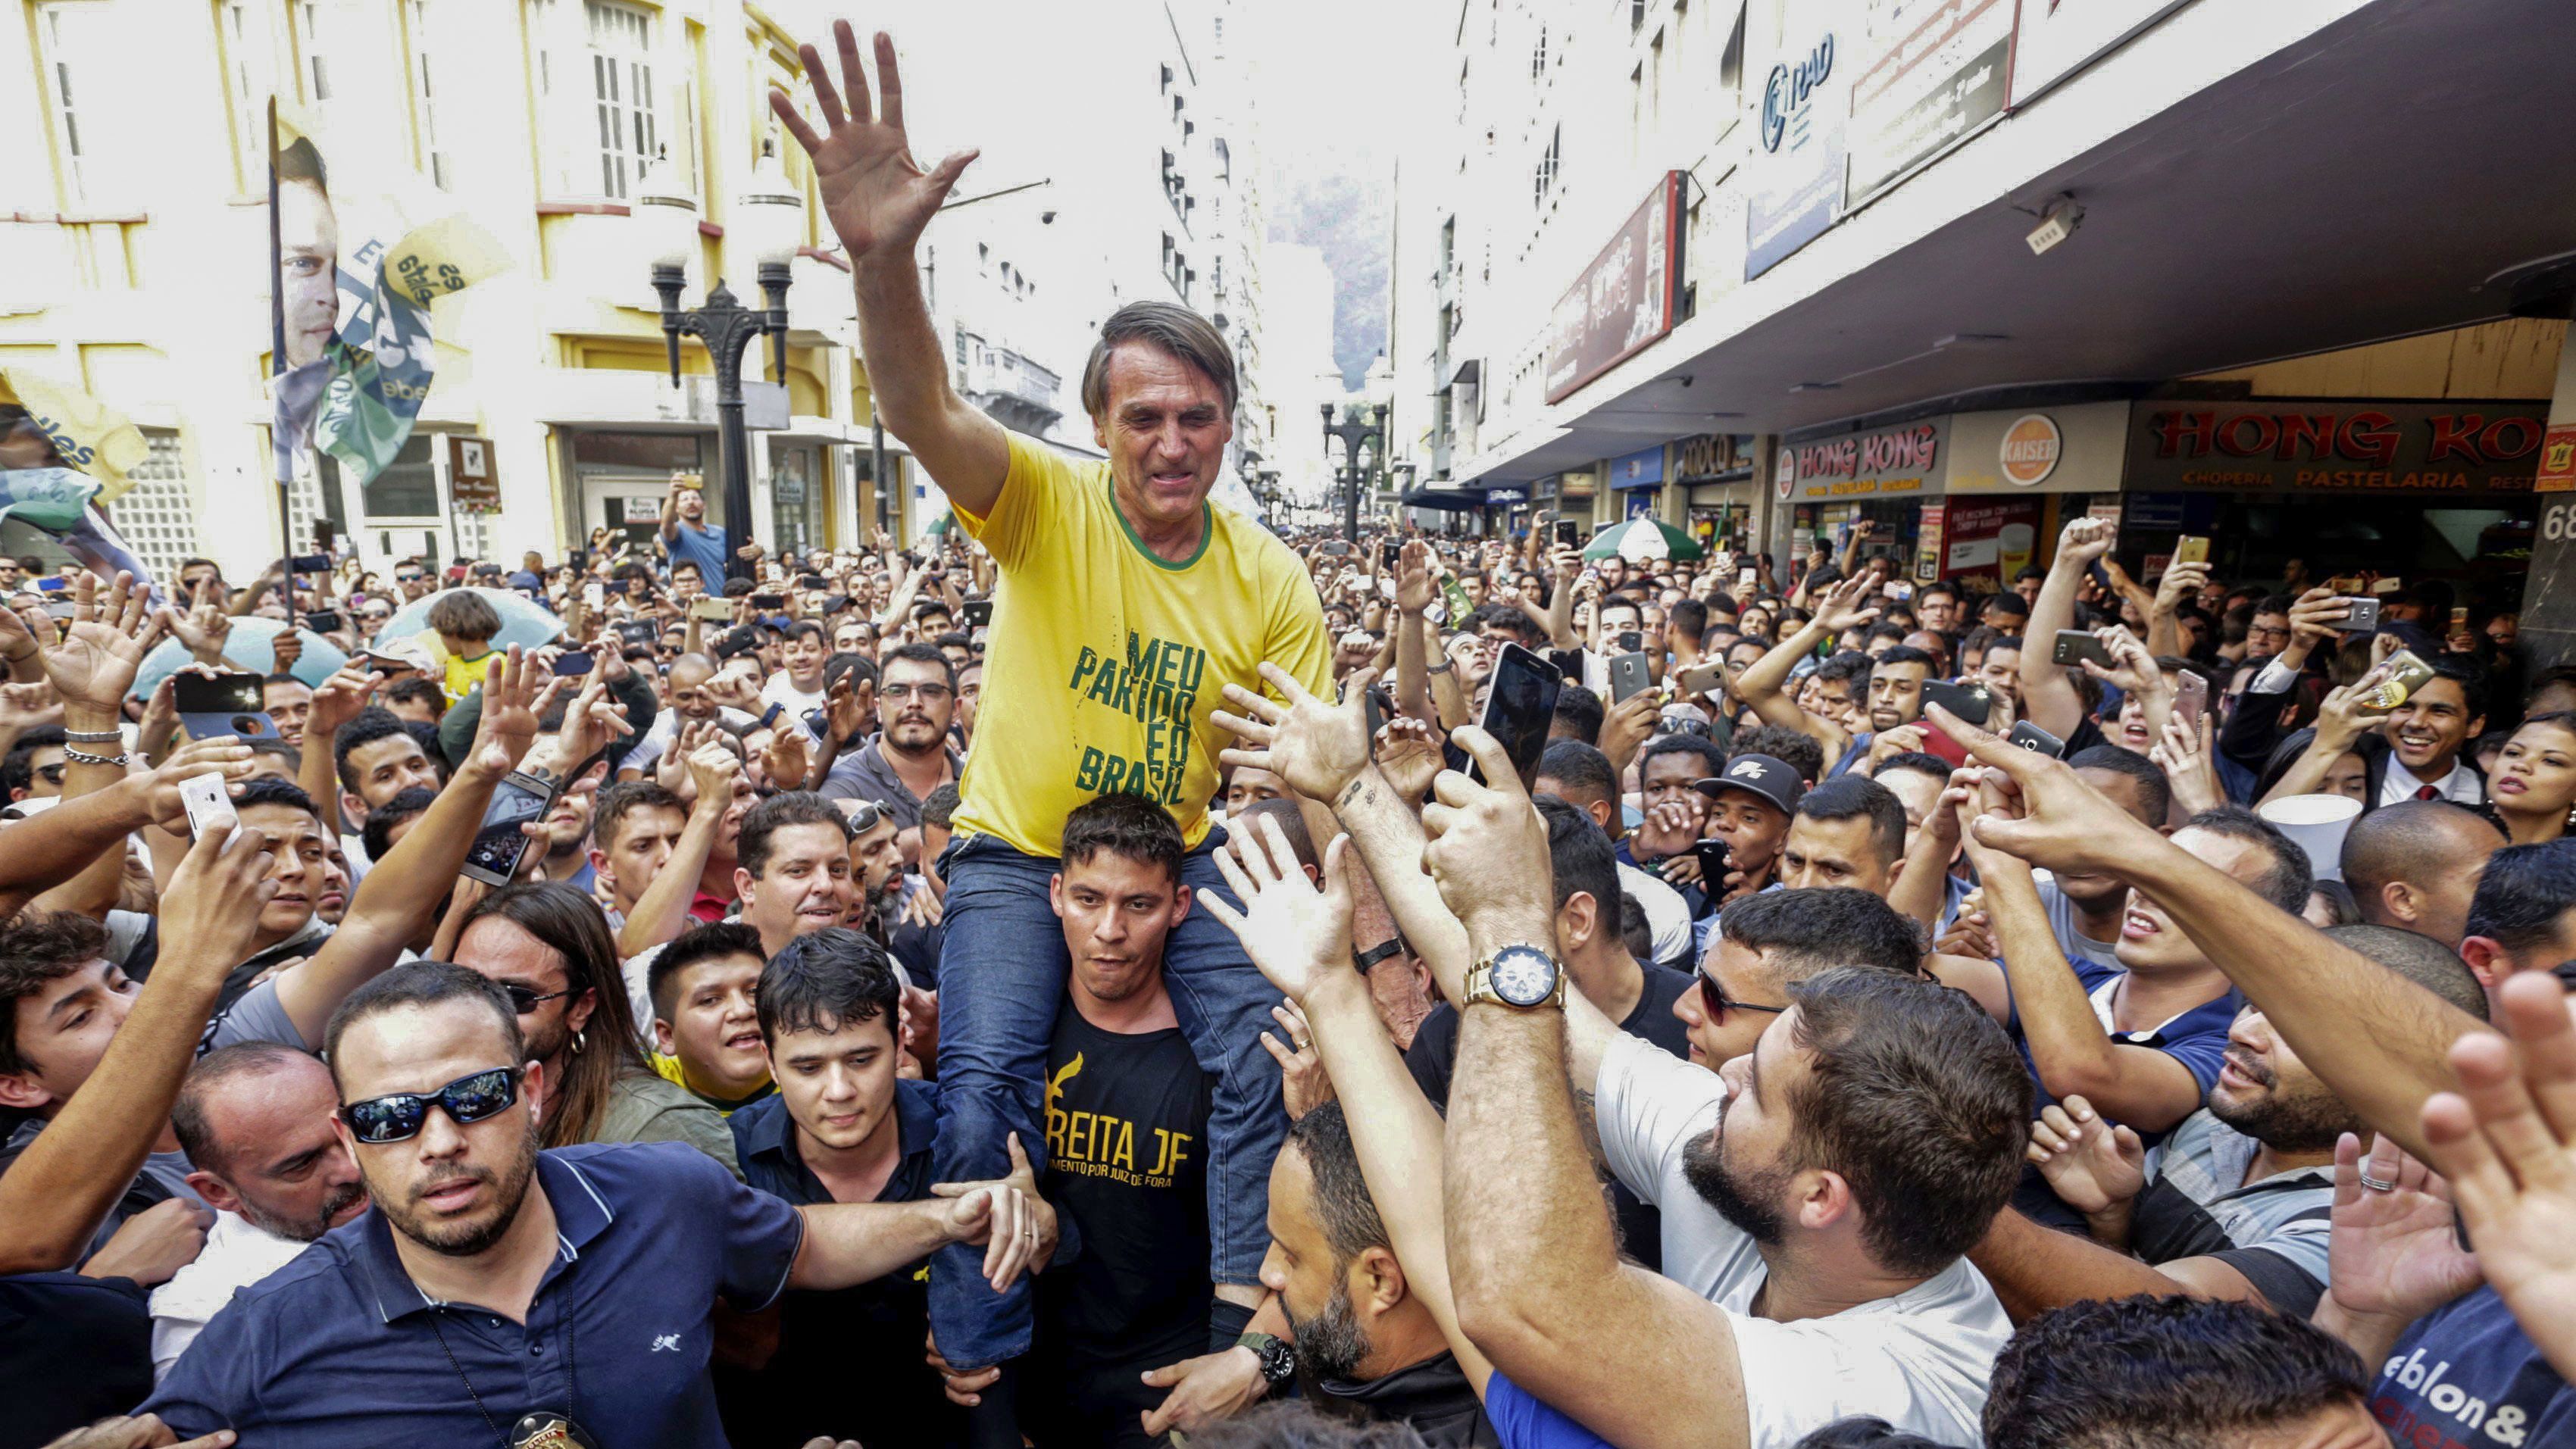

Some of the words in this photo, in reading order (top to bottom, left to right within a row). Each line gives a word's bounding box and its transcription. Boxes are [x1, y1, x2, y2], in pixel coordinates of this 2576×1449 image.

[1800, 439, 1857, 479] HONG
[1863, 425, 1935, 472] KONG
[2001, 438, 2057, 462] KAISER
[2158, 411, 2401, 467] HONG
[2428, 414, 2546, 464] KO
[2182, 471, 2274, 486] CHOPERIA
[2296, 470, 2468, 489] PASTELARIA
[1128, 631, 1206, 692] MEU
[1075, 745, 1186, 807] BRASIL
[1087, 1163, 1108, 1177] POR
[1109, 1167, 1130, 1183] JUIZ
[1130, 1174, 1143, 1187] DE
[1144, 1175, 1172, 1188] FORA
[1148, 1127, 1193, 1176] JF
[2484, 1404, 2528, 1448] &
